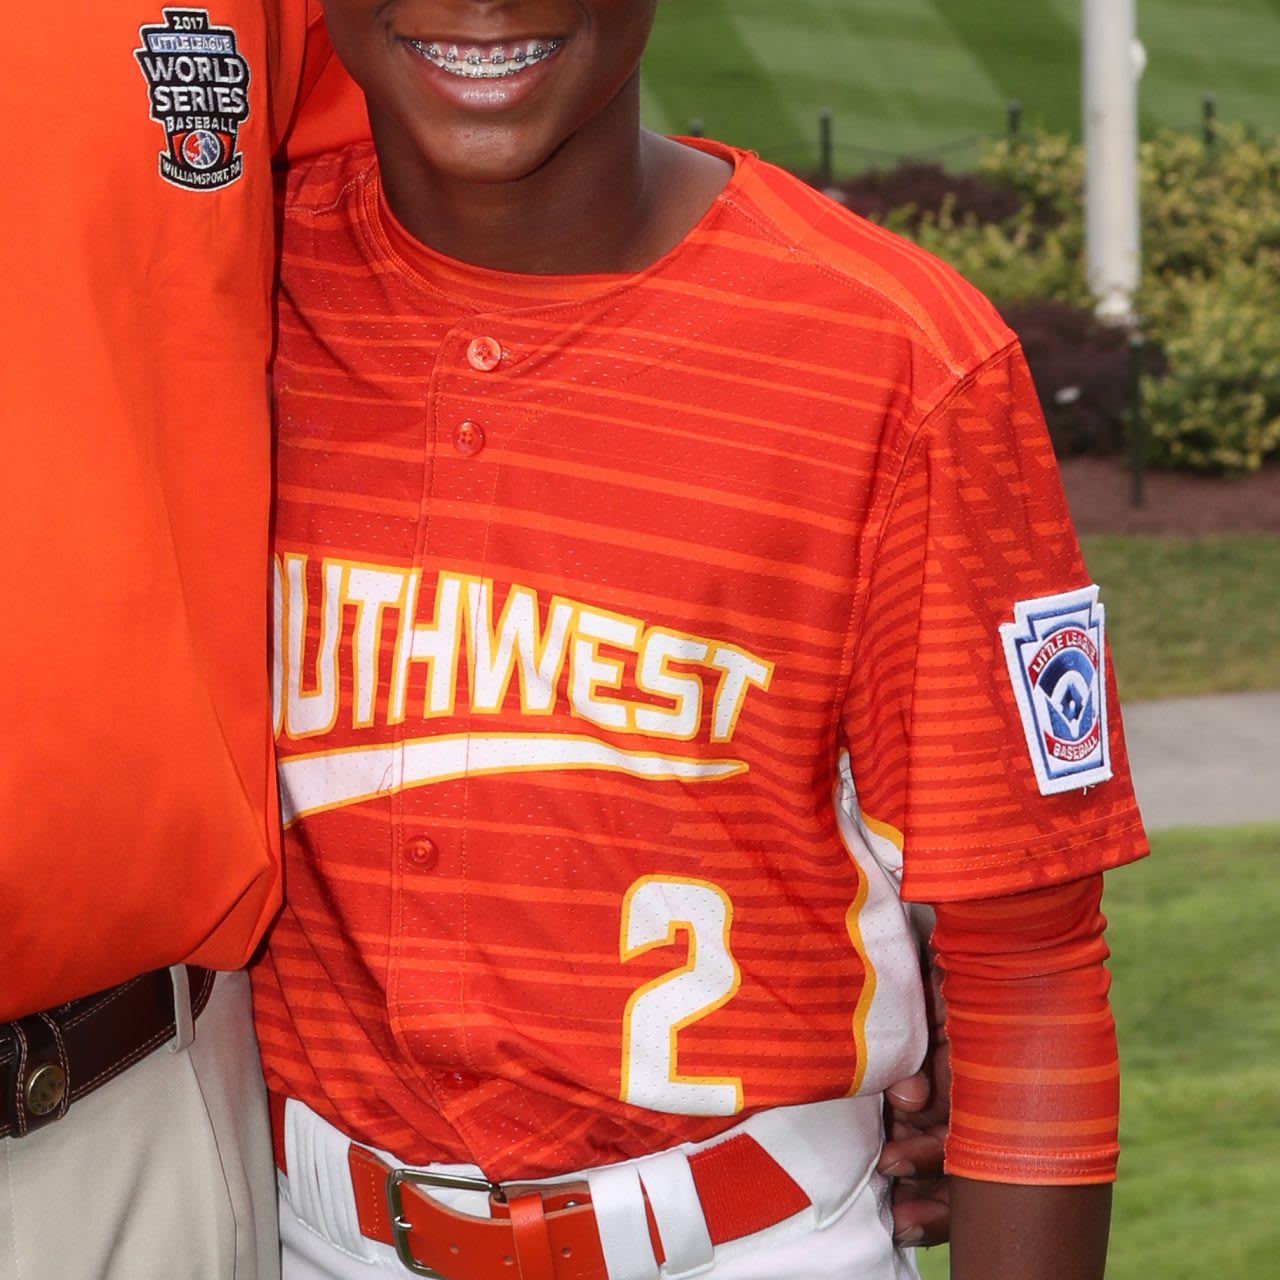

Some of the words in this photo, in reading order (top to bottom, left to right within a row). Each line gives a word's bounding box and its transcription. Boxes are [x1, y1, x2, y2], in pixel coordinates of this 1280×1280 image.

[172, 16, 205, 30] 2017
[150, 35, 189, 51] LITTLE
[190, 37, 233, 52] LEAGUE
[144, 56, 245, 84] WORLD
[154, 86, 245, 114] SERIES
[166, 116, 237, 133] BASEBALL
[274, 551, 775, 744] UTHWEST
[1032, 634, 1064, 673] LITTLE
[1053, 734, 1098, 761] BASEBALL
[619, 874, 744, 1117] 2
